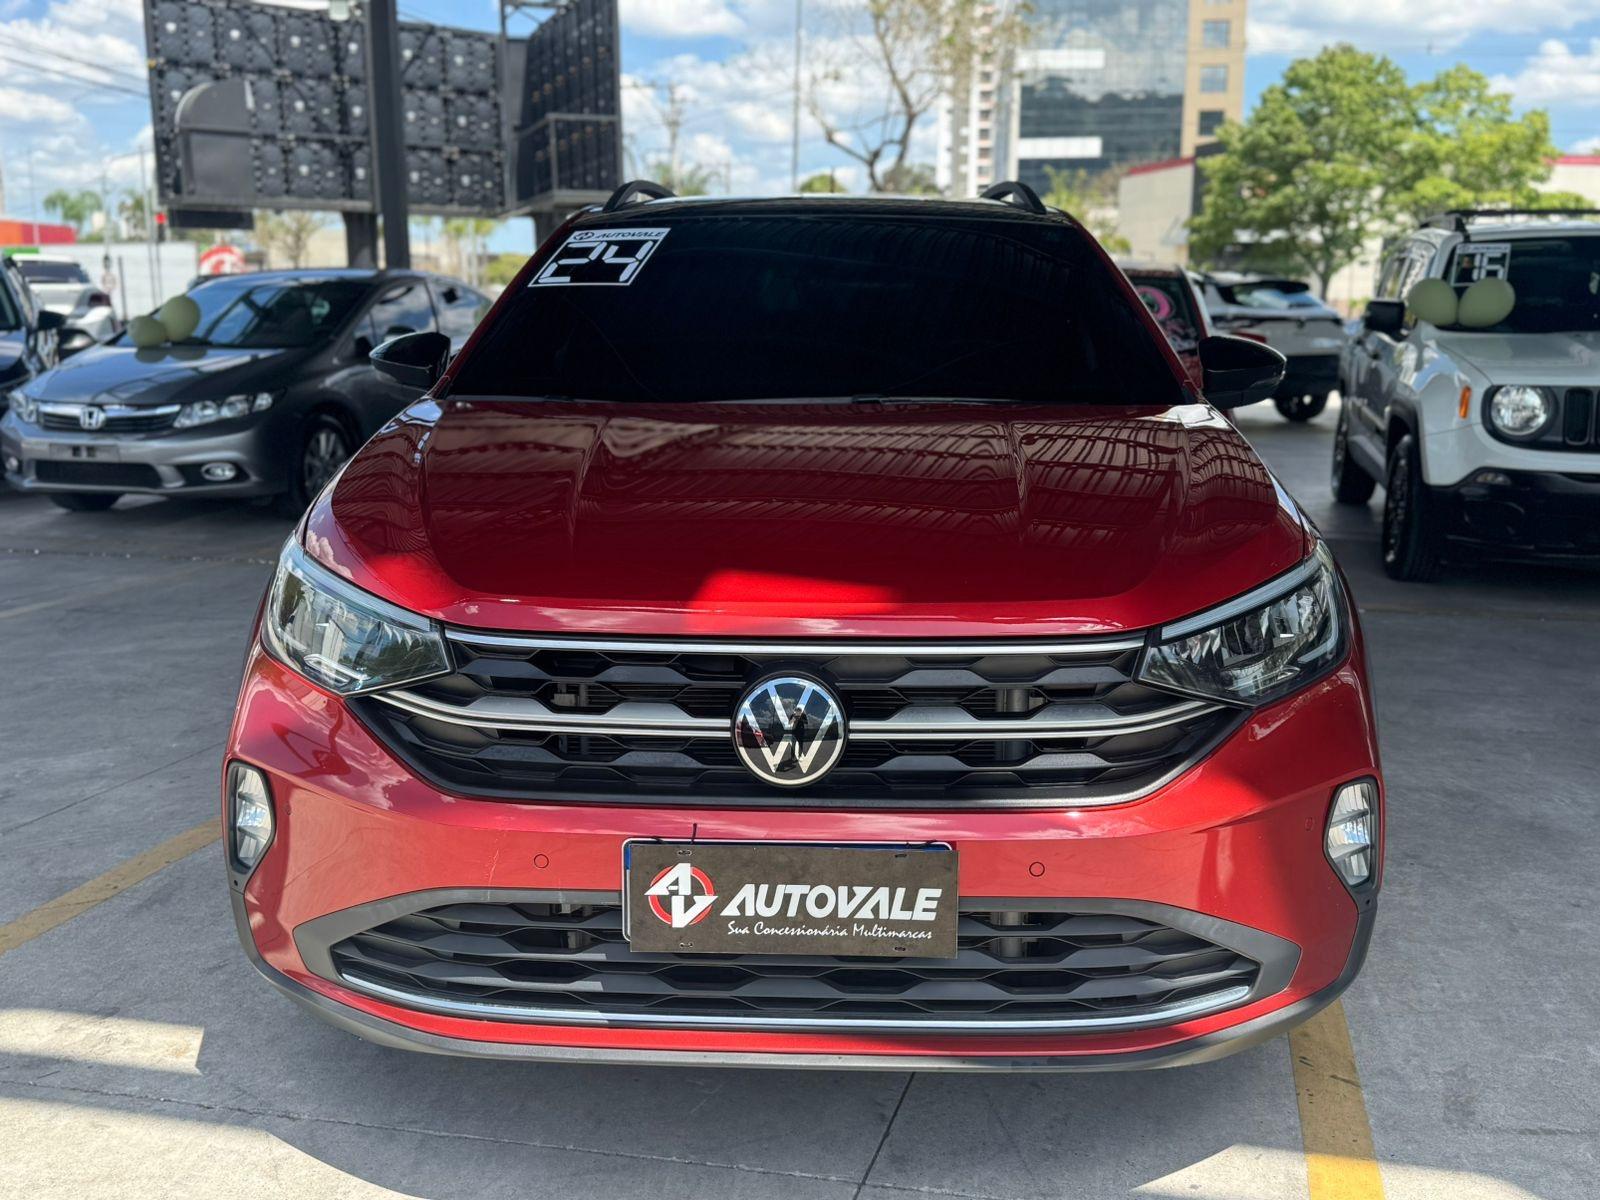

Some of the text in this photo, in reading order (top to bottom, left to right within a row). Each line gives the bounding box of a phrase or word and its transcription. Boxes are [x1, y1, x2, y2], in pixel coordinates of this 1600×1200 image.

[595, 231, 665, 239] AUTOVALE
[538, 240, 654, 283] 24
[720, 884, 942, 921] AUTOVALE
[727, 920, 932, 940] Sua Concessionária Multimarcas
